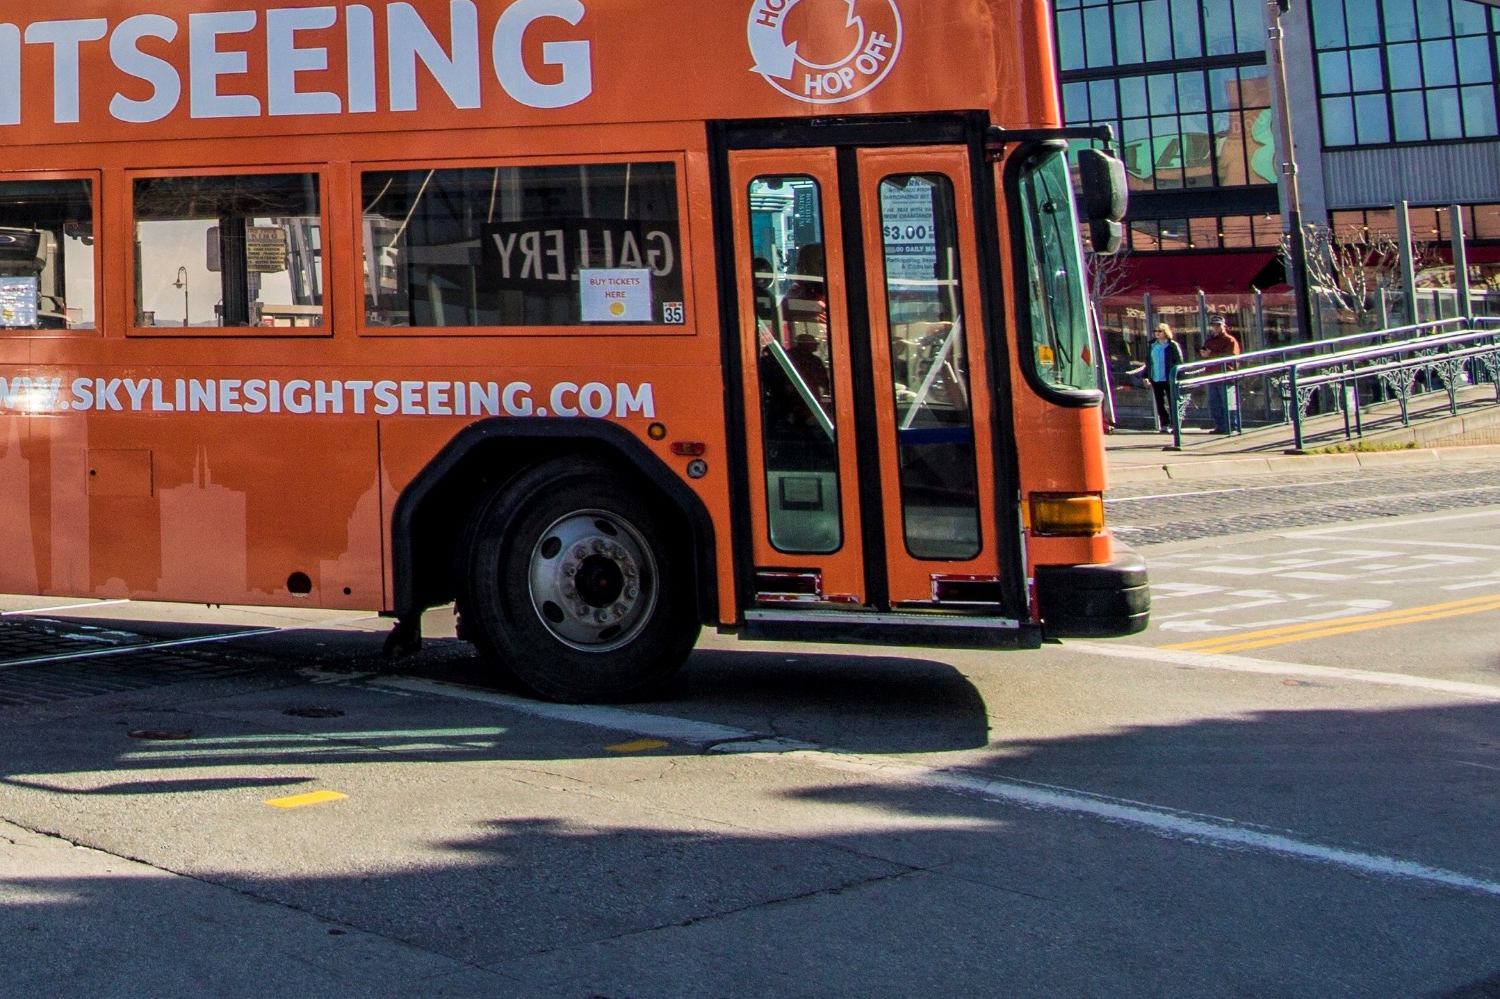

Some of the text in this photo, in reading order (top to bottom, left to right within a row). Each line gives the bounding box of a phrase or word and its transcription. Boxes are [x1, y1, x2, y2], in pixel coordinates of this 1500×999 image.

[804, 31, 893, 96] HOP OFF
[884, 225, 926, 240] $3.00
[608, 277, 640, 285] TICKETS
[665, 307, 682, 322] 35
